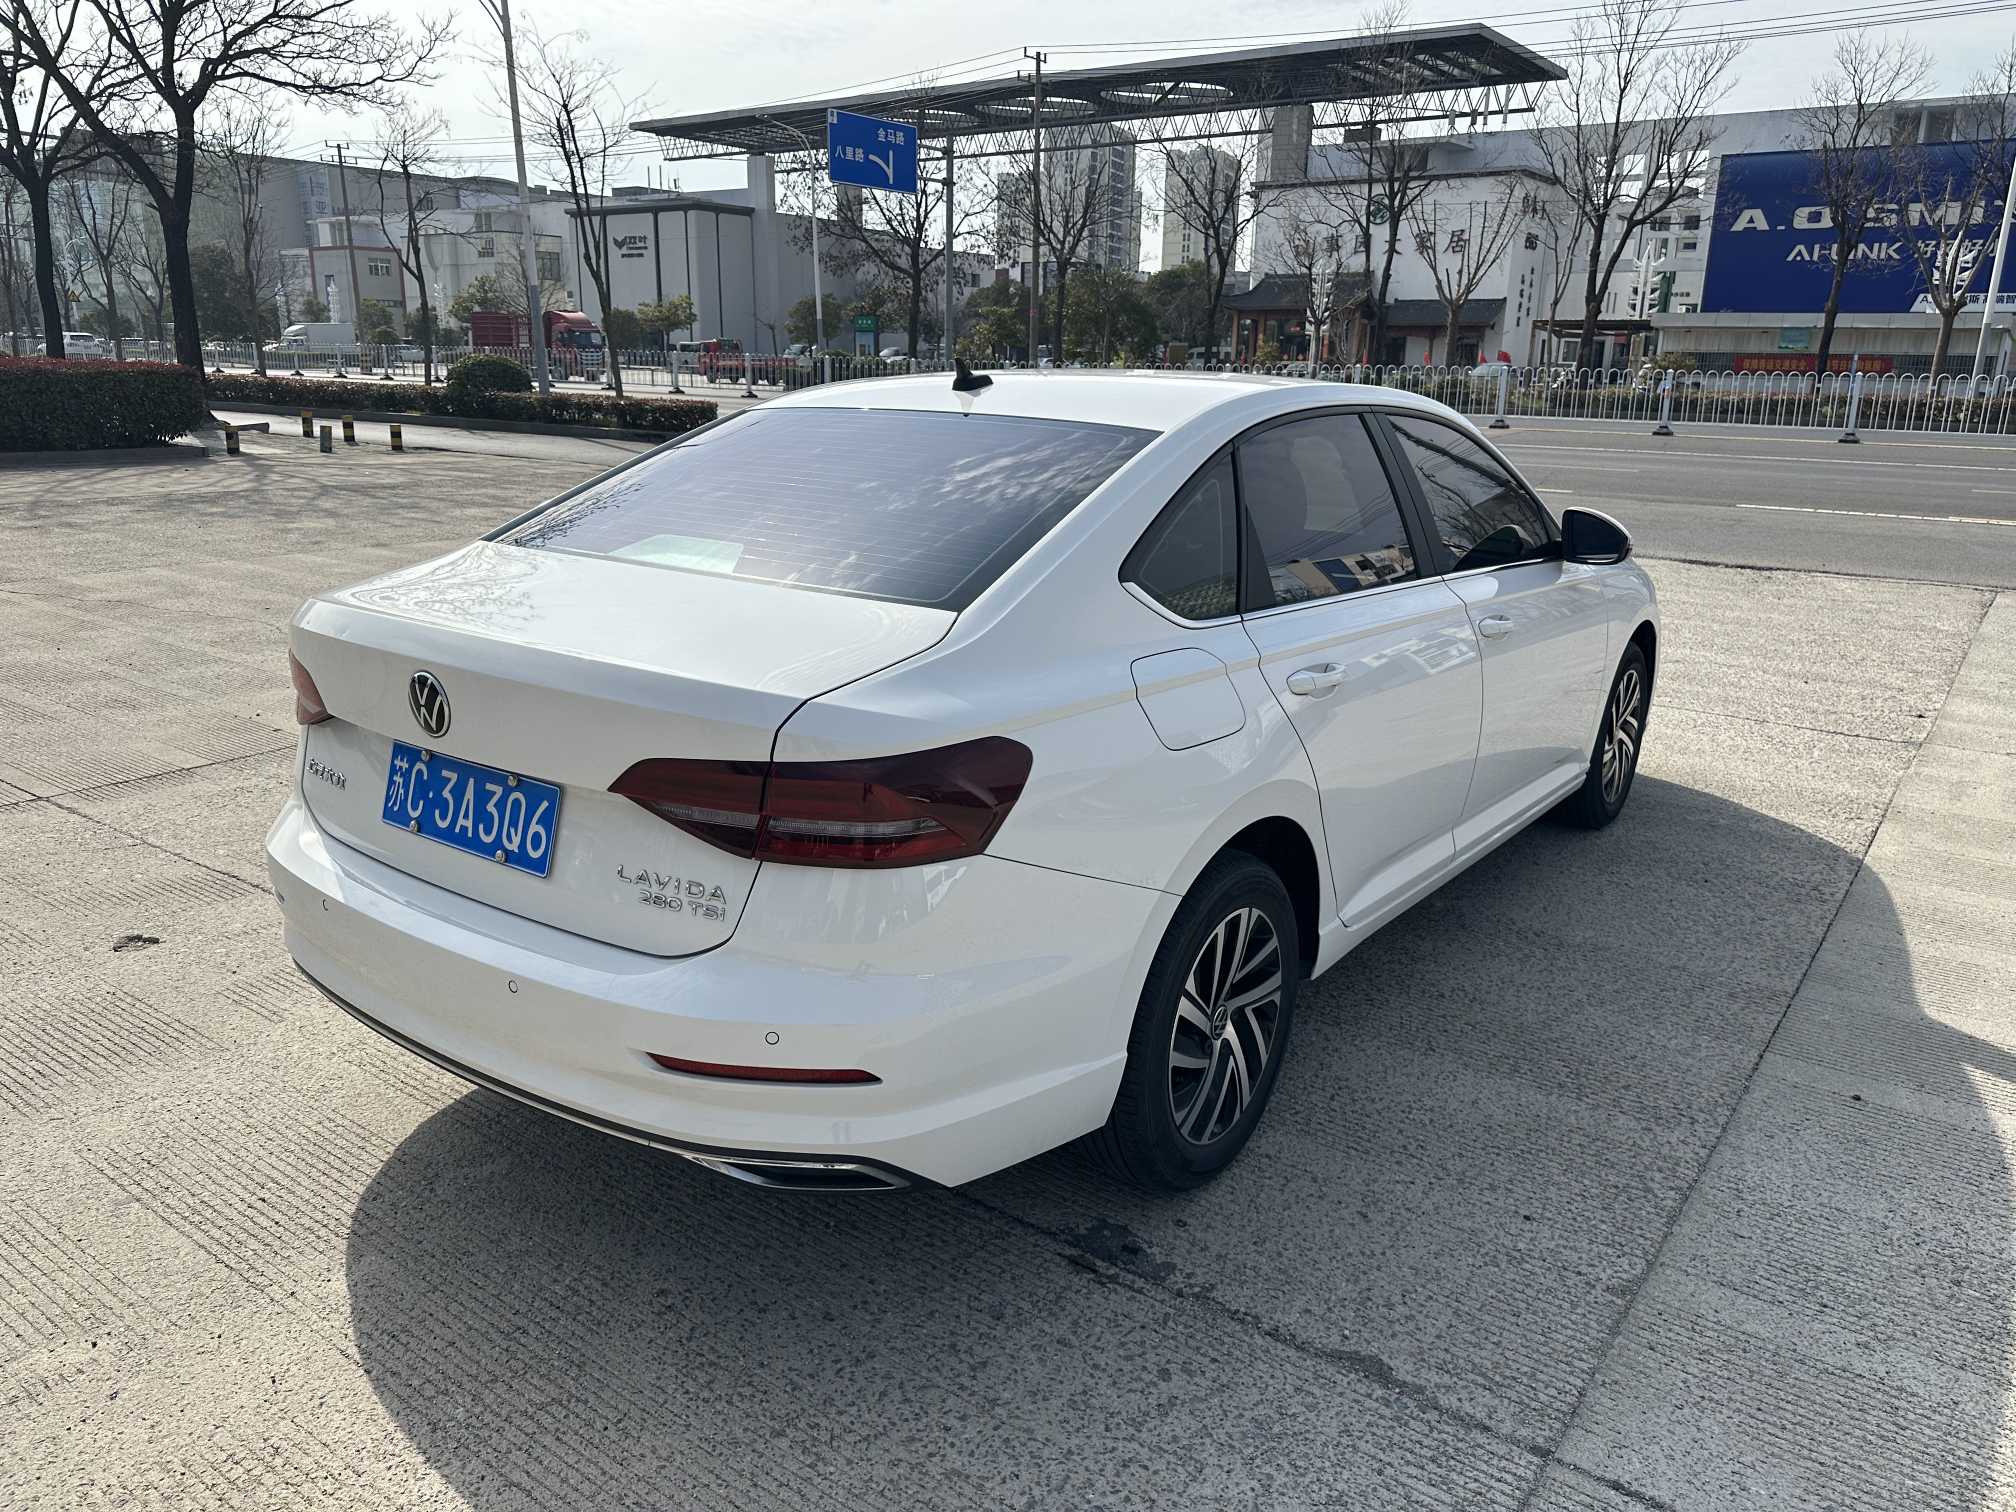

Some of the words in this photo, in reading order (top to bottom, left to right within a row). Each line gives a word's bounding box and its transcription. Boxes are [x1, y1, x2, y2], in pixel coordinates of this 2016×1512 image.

[877, 127, 905, 145] 金马路
[834, 145, 864, 162] 八里路
[617, 864, 727, 905] LAVIDA
[639, 889, 683, 912] 280
